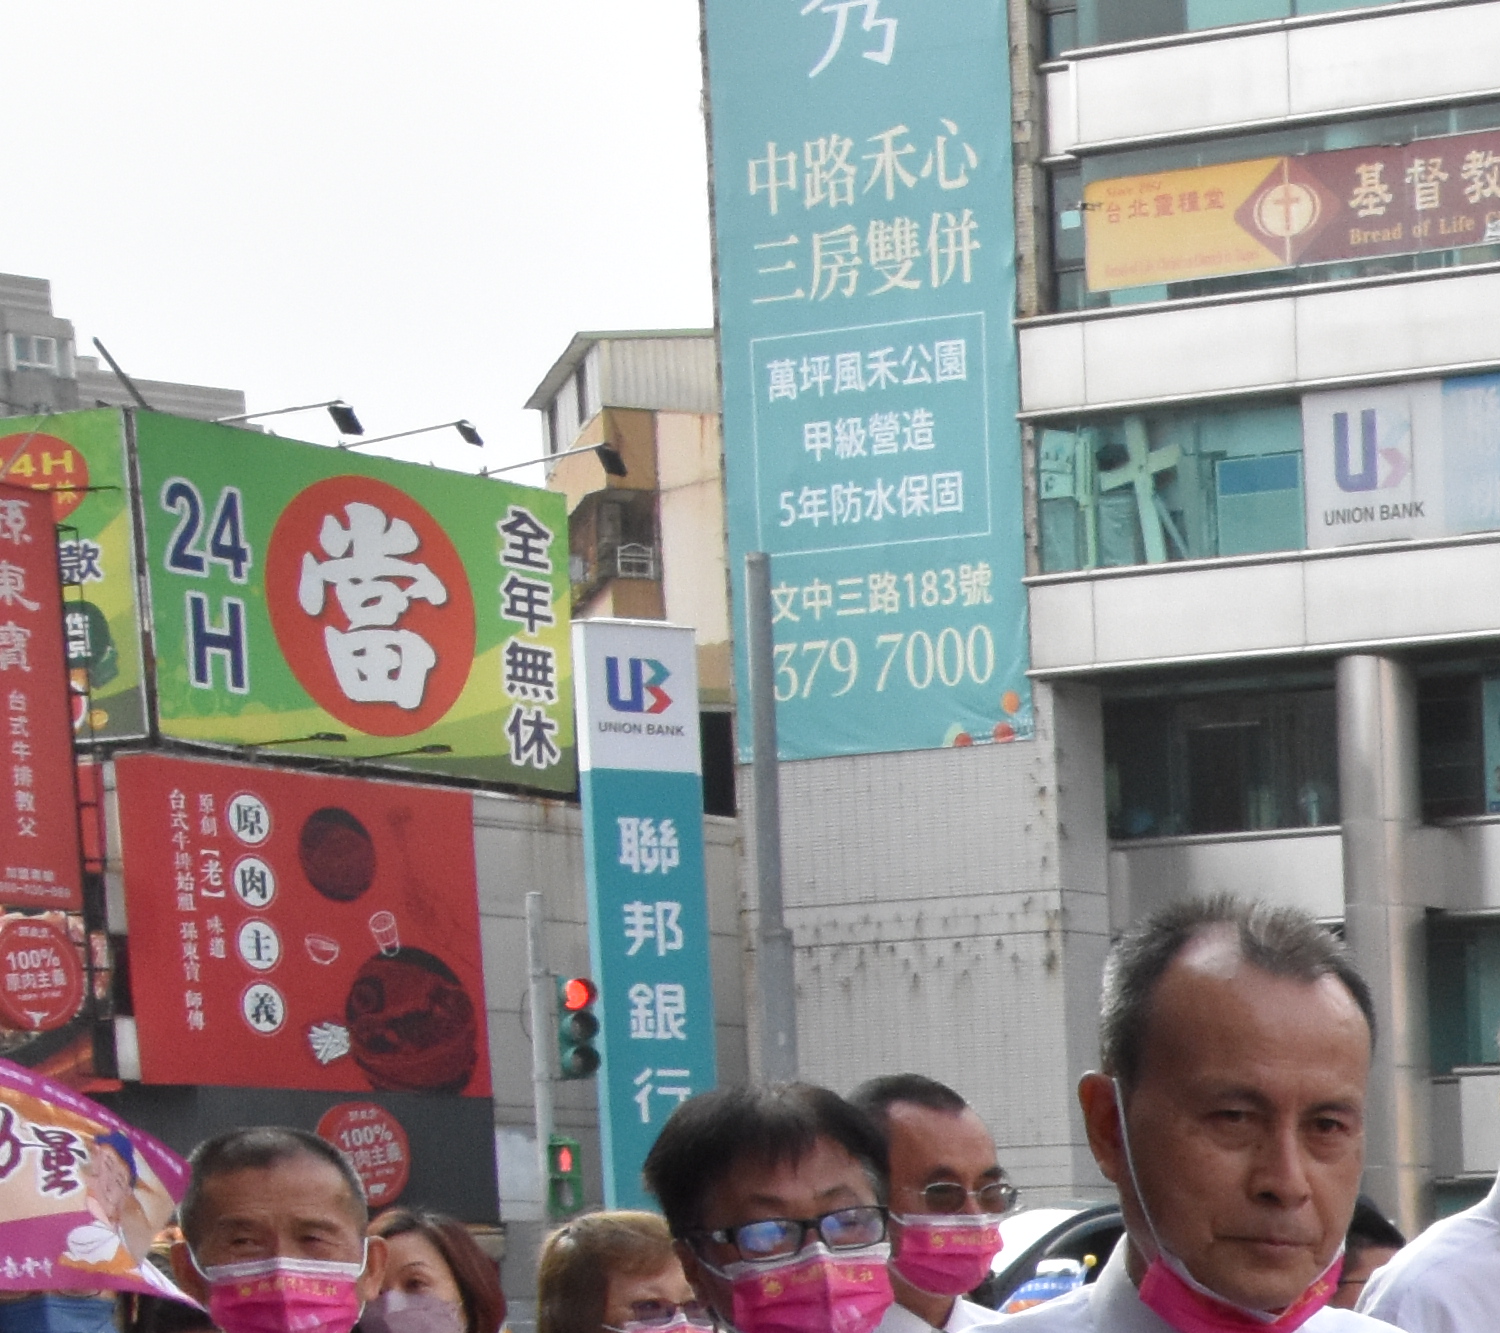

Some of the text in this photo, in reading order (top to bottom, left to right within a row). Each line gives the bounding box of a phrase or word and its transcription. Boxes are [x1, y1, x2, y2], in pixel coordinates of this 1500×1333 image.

[748, 117, 979, 217] 中路禾心
[752, 208, 980, 304] 三房雙併
[1350, 223, 1402, 245] Bread
[1412, 220, 1431, 237] of
[1439, 217, 1475, 235] Life
[767, 338, 967, 403] 萬坪風禾公園
[0, 450, 73, 477] 4H
[804, 408, 936, 462] 甲級營造
[165, 478, 250, 580] 24
[780, 471, 964, 527] 5年防水保固
[1324, 502, 1425, 527] UNION BANK
[298, 503, 447, 708] 當
[770, 563, 993, 624] 文中三路183號
[187, 603, 248, 692] H
[497, 507, 563, 766] 全年無休
[773, 624, 995, 702] 379 7000
[598, 722, 685, 736] UNION BANK
[234, 803, 278, 1026] 原肉主義
[6, 948, 61, 970] 100%
[617, 816, 692, 1123] 聯邦銀行
[340, 1123, 393, 1148] 100%
